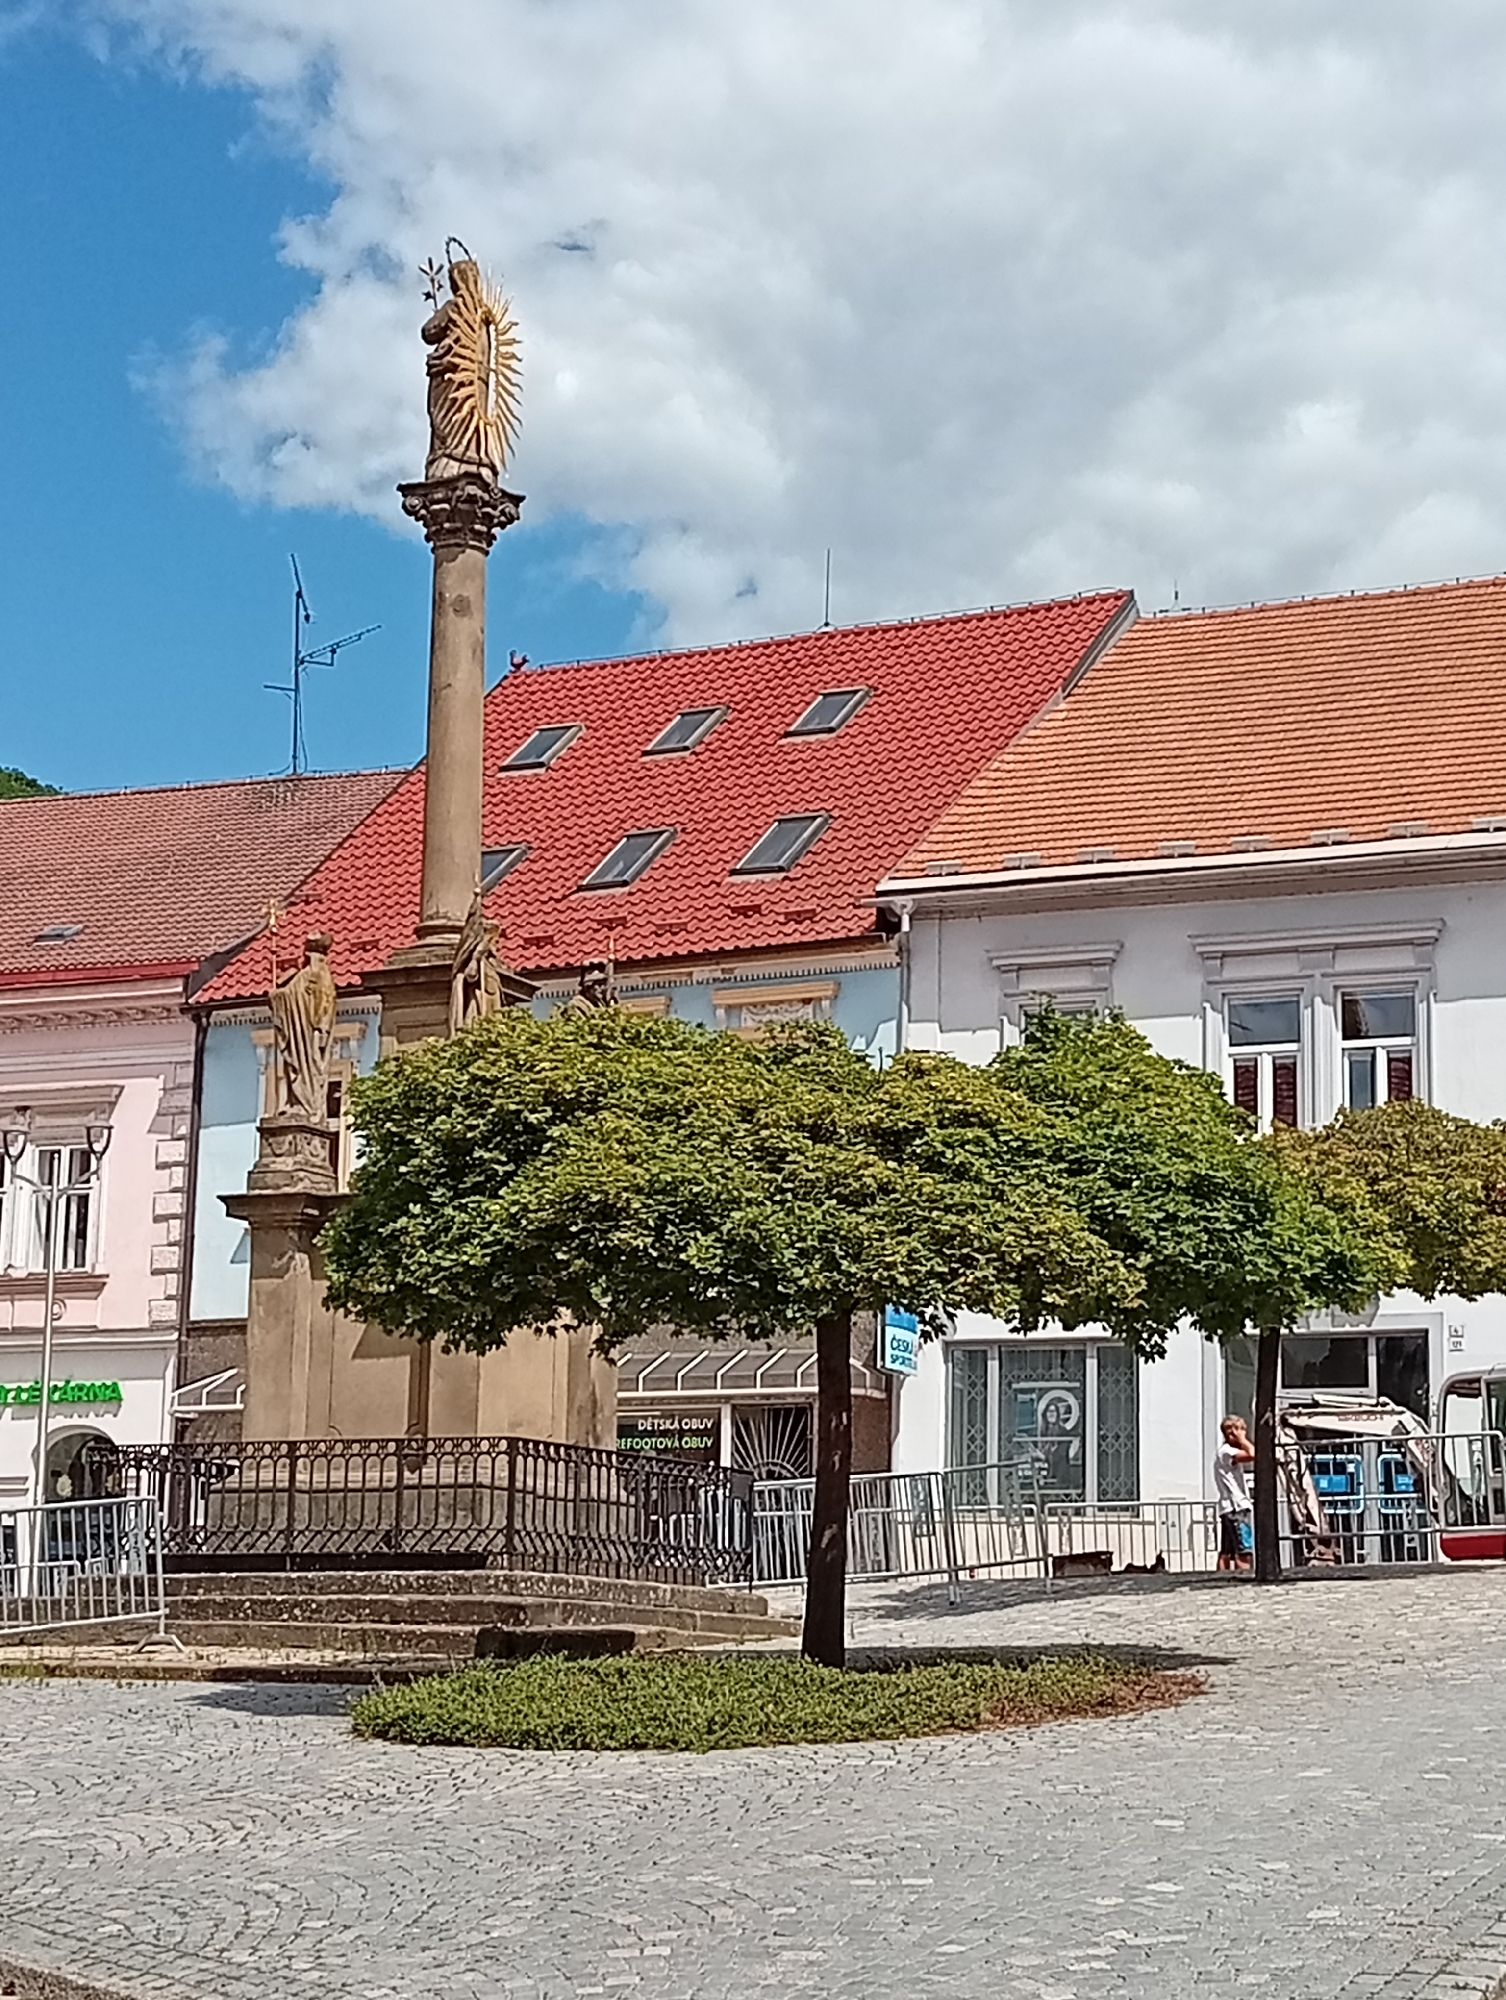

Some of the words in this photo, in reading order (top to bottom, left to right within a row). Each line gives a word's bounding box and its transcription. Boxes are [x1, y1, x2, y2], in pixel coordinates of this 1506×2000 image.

[638, 1415, 679, 1430] DĚTSKÁ
[681, 1418, 713, 1430] OBUV
[681, 1437, 713, 1448] OBUV
